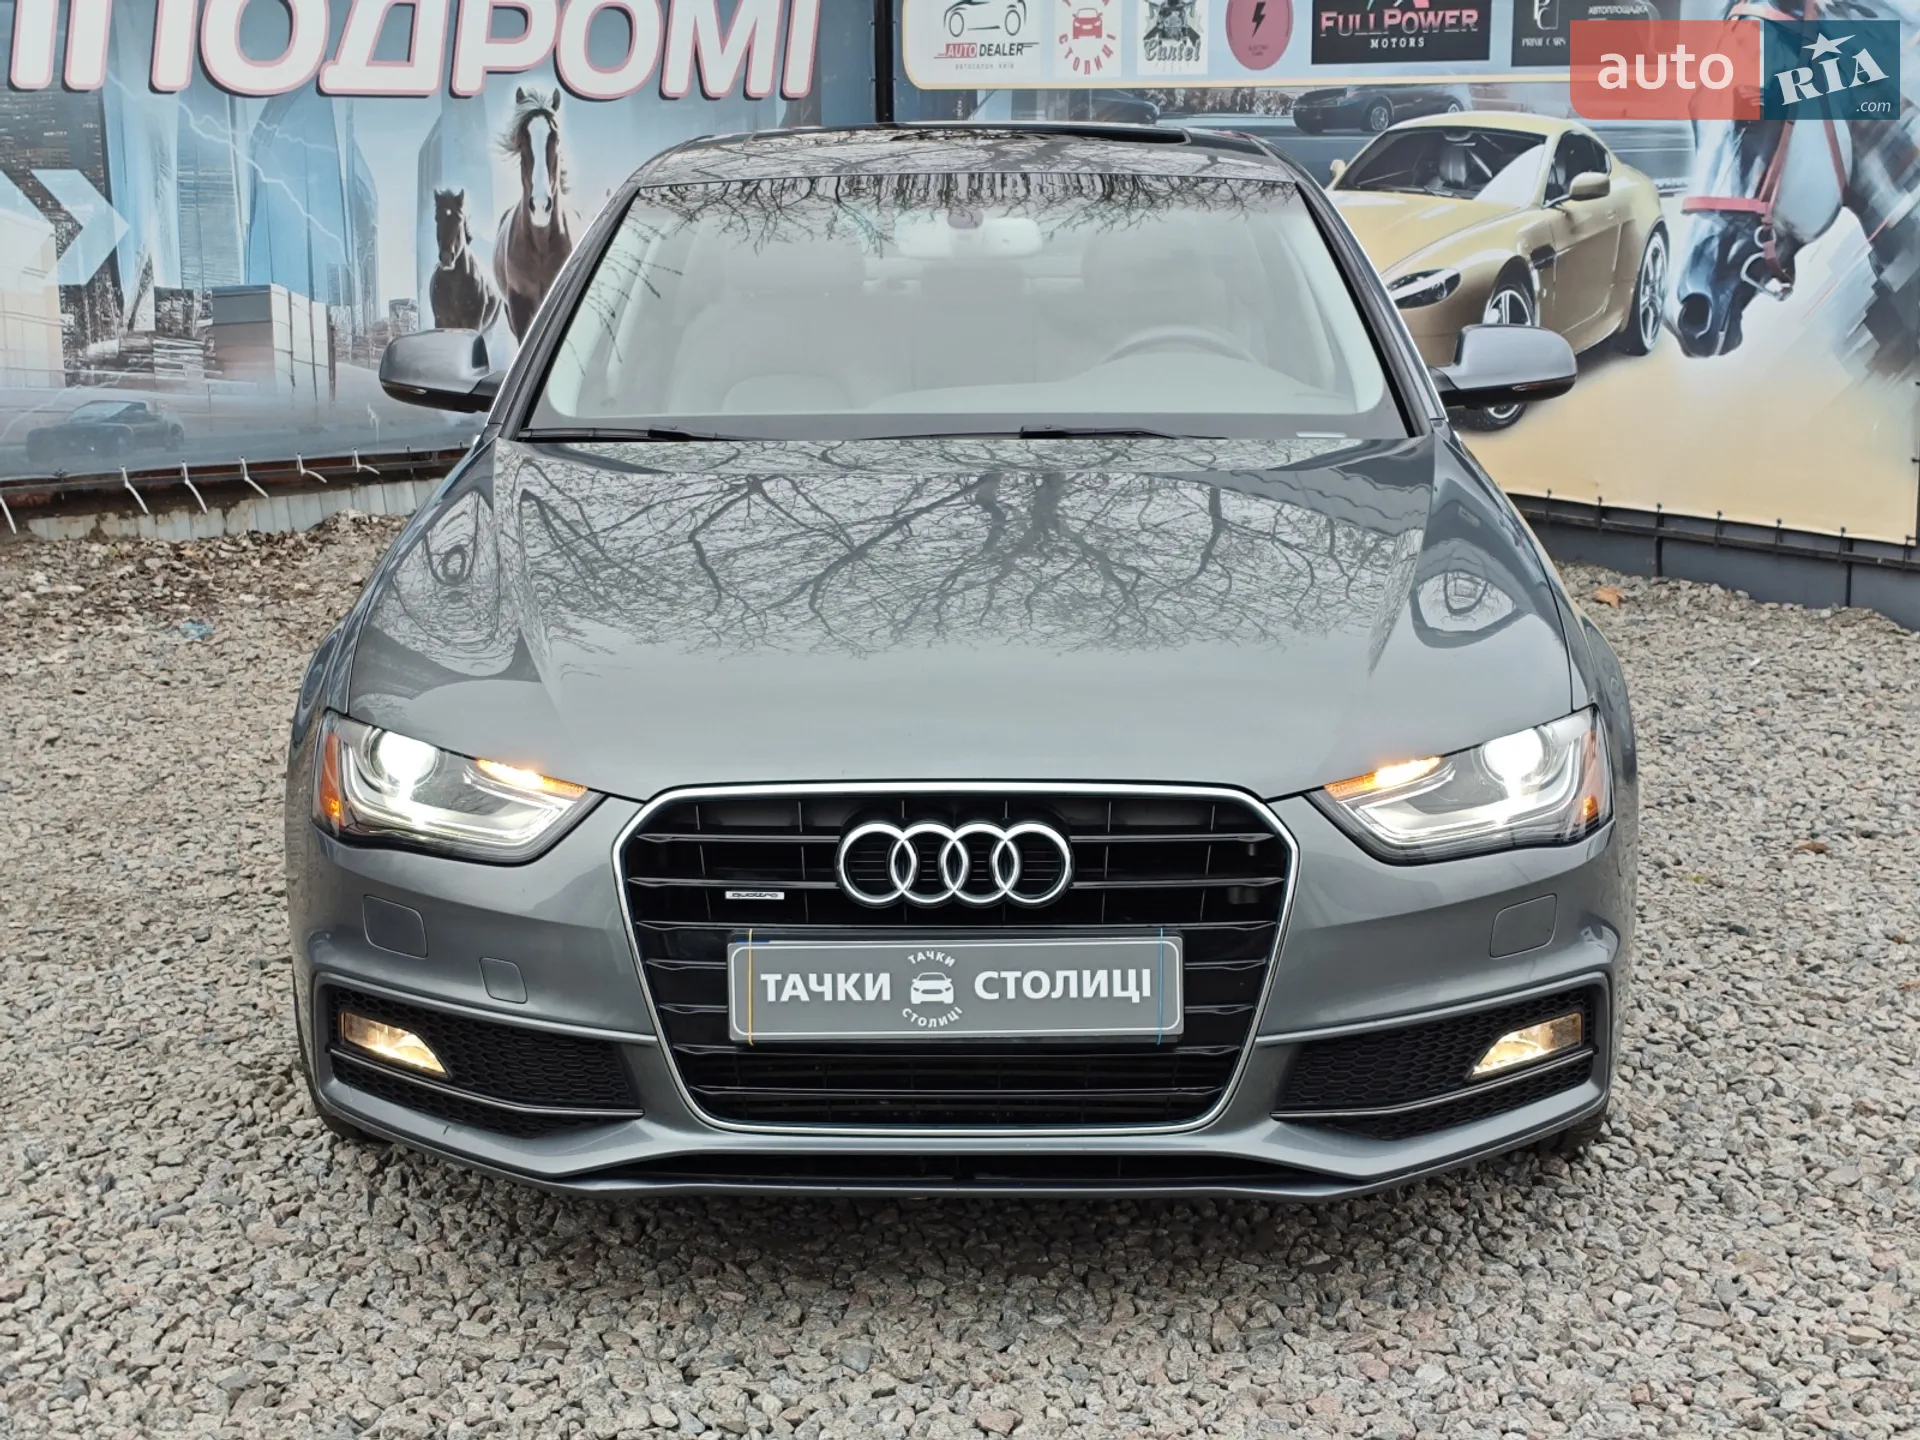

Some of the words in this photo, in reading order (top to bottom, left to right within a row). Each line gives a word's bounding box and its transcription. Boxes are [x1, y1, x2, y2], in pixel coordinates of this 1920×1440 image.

[946, 43, 977, 58] AUTO
[979, 43, 1024, 57] DEALER
[1370, 37, 1425, 48] MOTORS
[730, 891, 780, 899] quattro
[906, 950, 956, 968] ТАЧКИ
[760, 972, 891, 1002] ТАЧКИ
[974, 968, 1152, 1004] СТОЛИЦІ
[902, 1005, 963, 1029] СТОЛИЦІ
